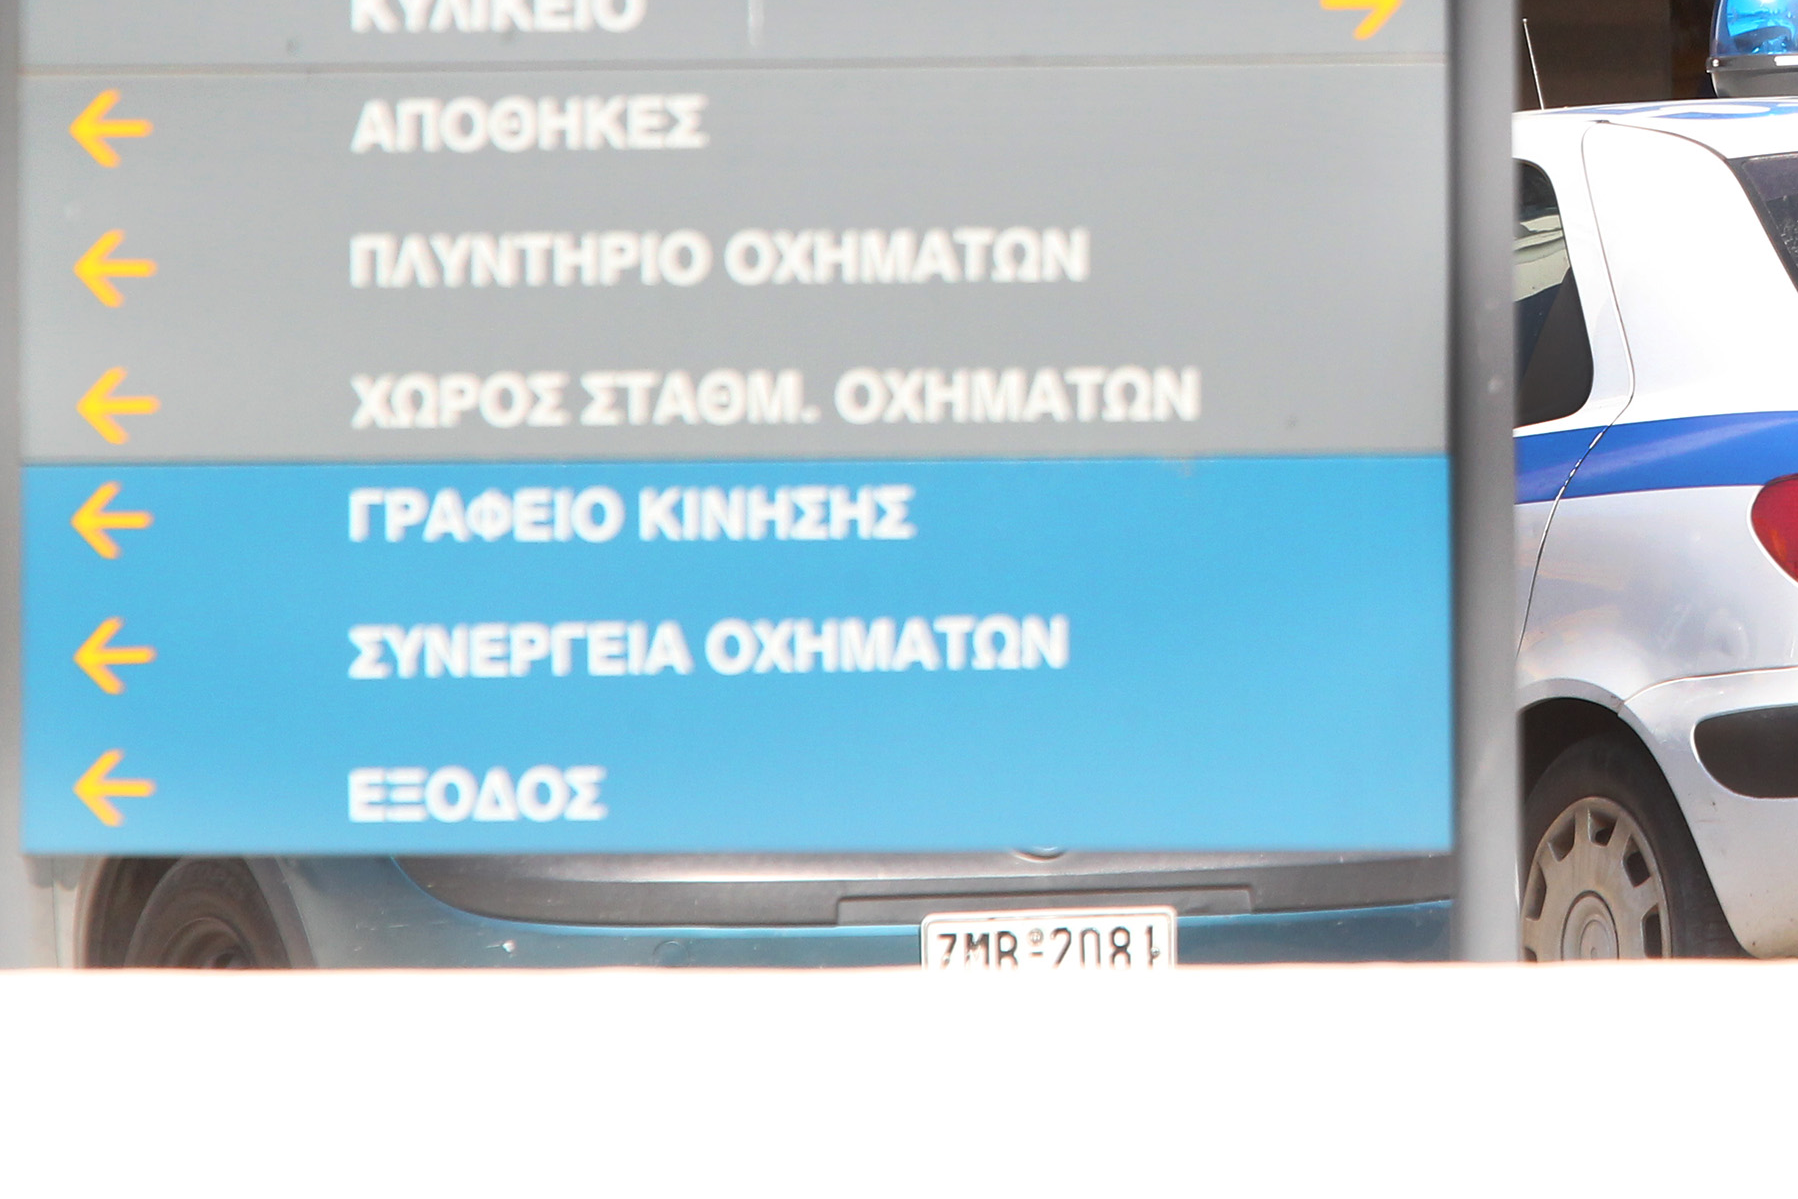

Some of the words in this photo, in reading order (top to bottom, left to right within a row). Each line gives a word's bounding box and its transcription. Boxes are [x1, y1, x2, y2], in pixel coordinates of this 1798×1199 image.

[353, 96, 708, 153] ΑΠΟΘΗΚΕΣ
[352, 232, 710, 287] ΠΛΥΝΤΗΡΙΟ
[726, 230, 1088, 285] ΟΧΗΜΑΤΩΝ
[353, 374, 566, 429] ΧΩΡΟΣ
[582, 371, 816, 427] ΣΤΑΘΜ.
[836, 369, 1199, 425] ΟΧΗΜΑΤΩΝ
[350, 487, 627, 544] ΓΡΑΦΕΙΟ
[641, 486, 915, 541] ΚΙΝΗΣΗΣ
[351, 623, 694, 680] ΣΥΝΕΡΓΕΙΑ
[706, 617, 1069, 674] ΟΧΗΜΑΤΩΝ
[350, 767, 607, 823] ΕΞΟΔΟΣ
